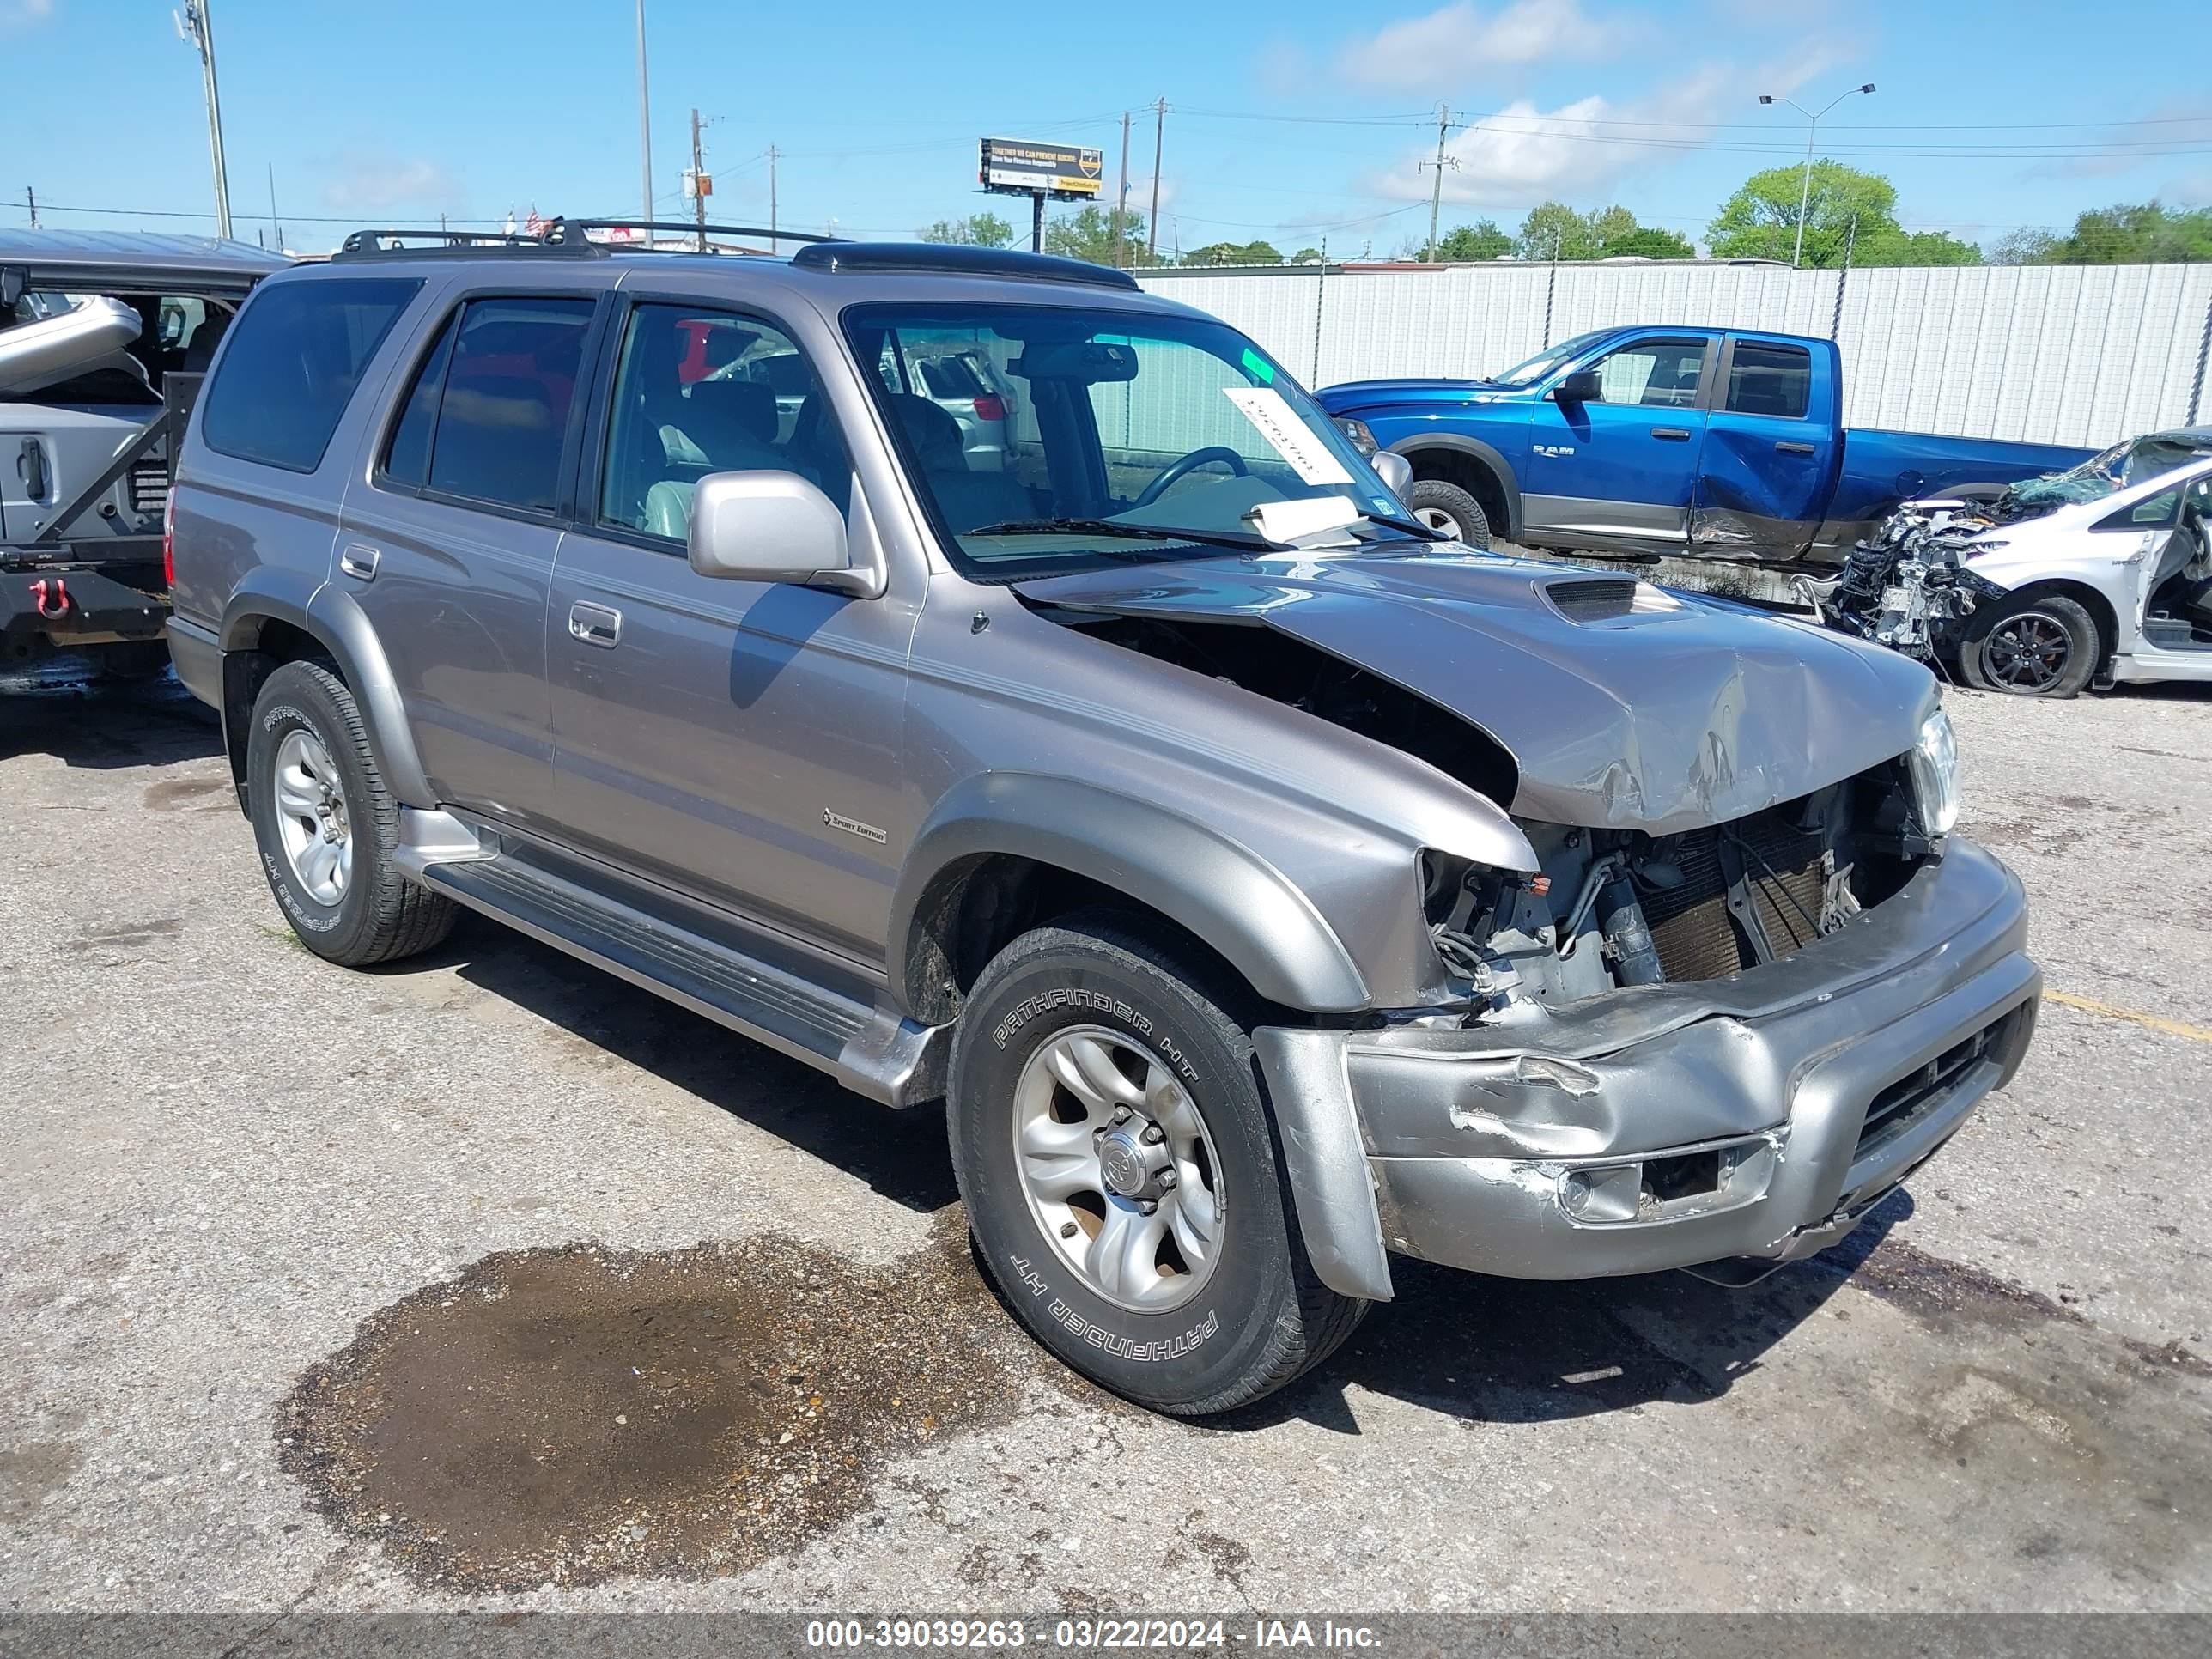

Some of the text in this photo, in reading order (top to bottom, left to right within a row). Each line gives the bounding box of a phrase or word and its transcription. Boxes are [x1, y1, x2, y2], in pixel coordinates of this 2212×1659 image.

[1533, 445, 1575, 455] RAM
[992, 988, 1199, 1082] PATHFINDER HT
[1010, 1255, 1220, 1362] PATHFINDER HT
